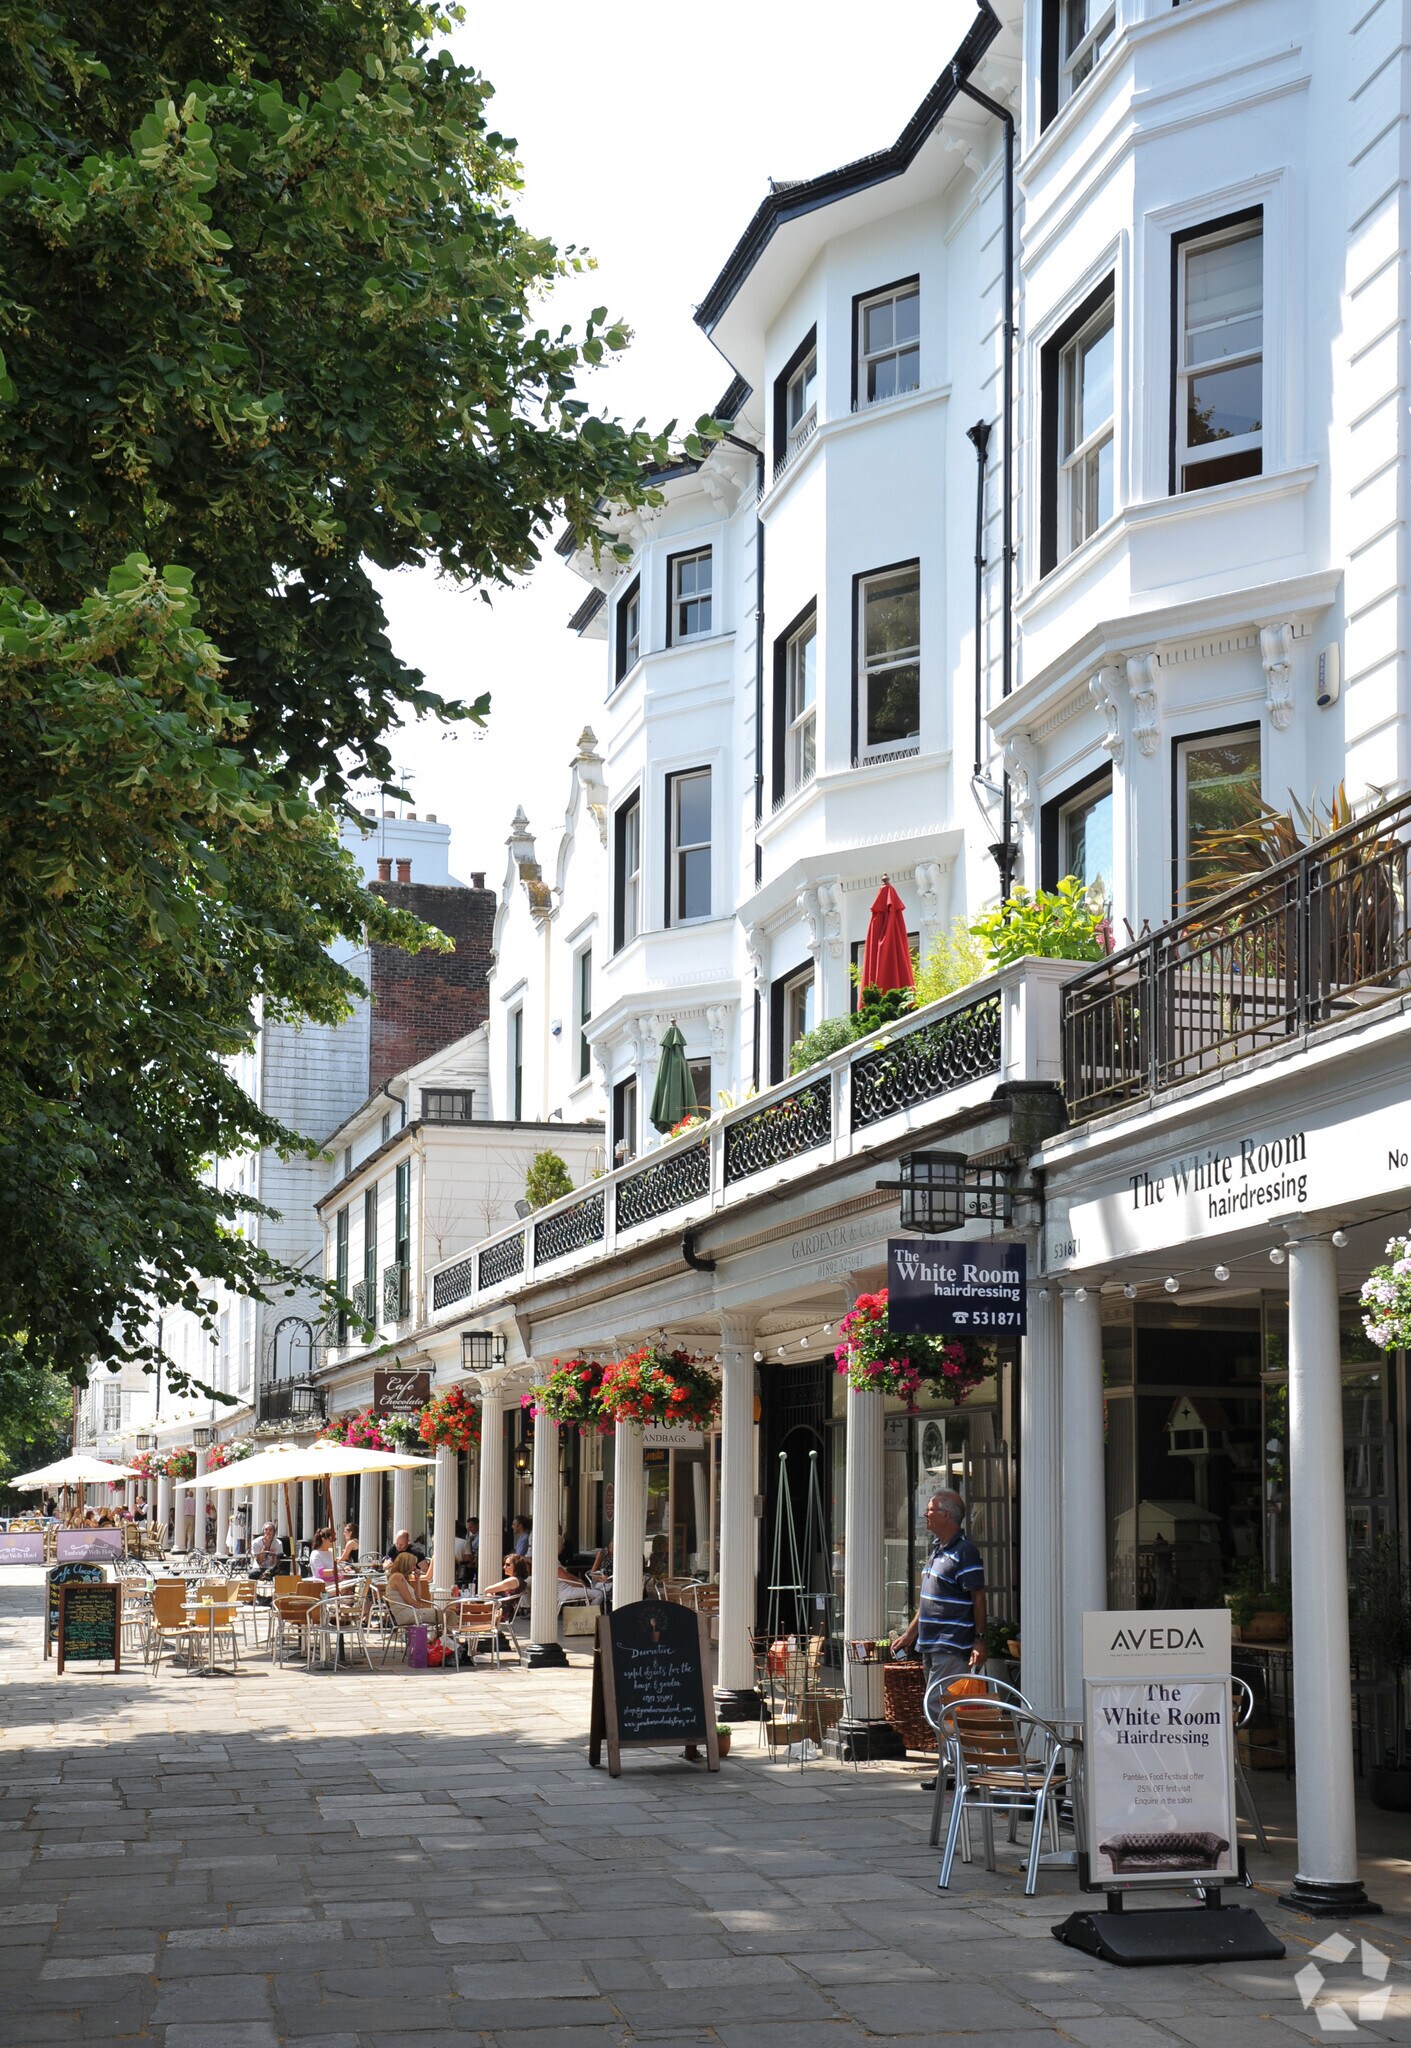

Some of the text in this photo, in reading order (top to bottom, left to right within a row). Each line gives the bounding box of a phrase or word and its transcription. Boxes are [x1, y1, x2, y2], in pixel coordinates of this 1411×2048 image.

[1129, 1131, 1307, 1210] The White Room
[1208, 1172, 1308, 1219] hairdressing
[792, 1226, 847, 1259] GARDENER
[1054, 1238, 1081, 1259] 531871
[894, 1249, 920, 1263] The
[896, 1262, 1020, 1284] White Room
[934, 1284, 1020, 1301] hairdressing
[972, 1312, 1022, 1326] 531871
[386, 1374, 418, 1400] Cafe
[380, 1394, 424, 1406] Chocolata
[643, 1434, 686, 1443] ANDBAGS
[1110, 1627, 1204, 1650] AVEDA
[1143, 1684, 1182, 1702] The
[1103, 1707, 1221, 1725] White Room
[1116, 1729, 1209, 1747] Hairdressing
[1150, 1772, 1163, 1780] Food
[1164, 1772, 1188, 1780] Festival
[1189, 1772, 1205, 1780] offer
[1137, 1785, 1152, 1793] 25%
[1165, 1784, 1177, 1792] first
[1178, 1784, 1191, 1792] visit
[1134, 1797, 1159, 1805] Enquire
[1177, 1796, 1192, 1804] salon
